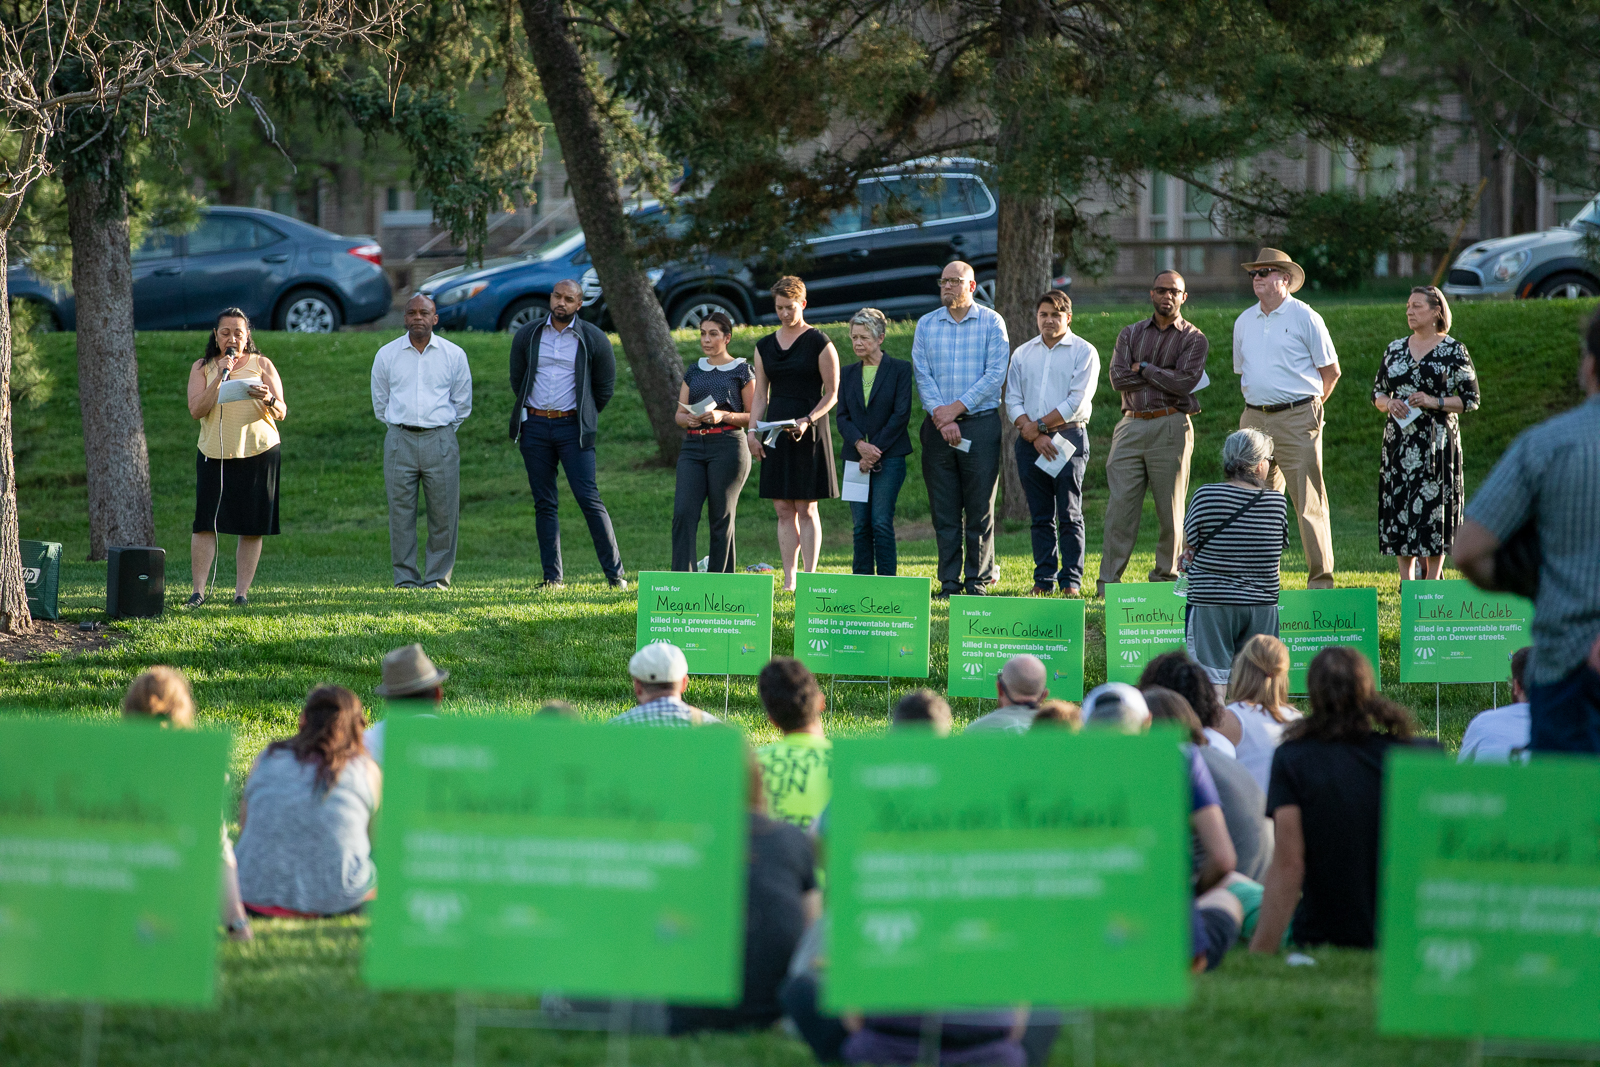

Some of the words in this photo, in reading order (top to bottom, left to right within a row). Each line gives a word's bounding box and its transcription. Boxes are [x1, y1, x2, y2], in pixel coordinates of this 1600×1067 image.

[23, 567, 35, 584] hp
[657, 595, 700, 616] Megan
[704, 593, 745, 613] Nelson
[816, 597, 856, 613] James
[860, 597, 901, 613] Steele
[1460, 601, 1512, 619] McCaleb
[1122, 608, 1174, 626] Timothy
[1313, 611, 1356, 633] Roybal
[969, 619, 1008, 636] Kevin
[1013, 622, 1062, 638] Caldwell
[1295, 635, 1338, 644] preventable
